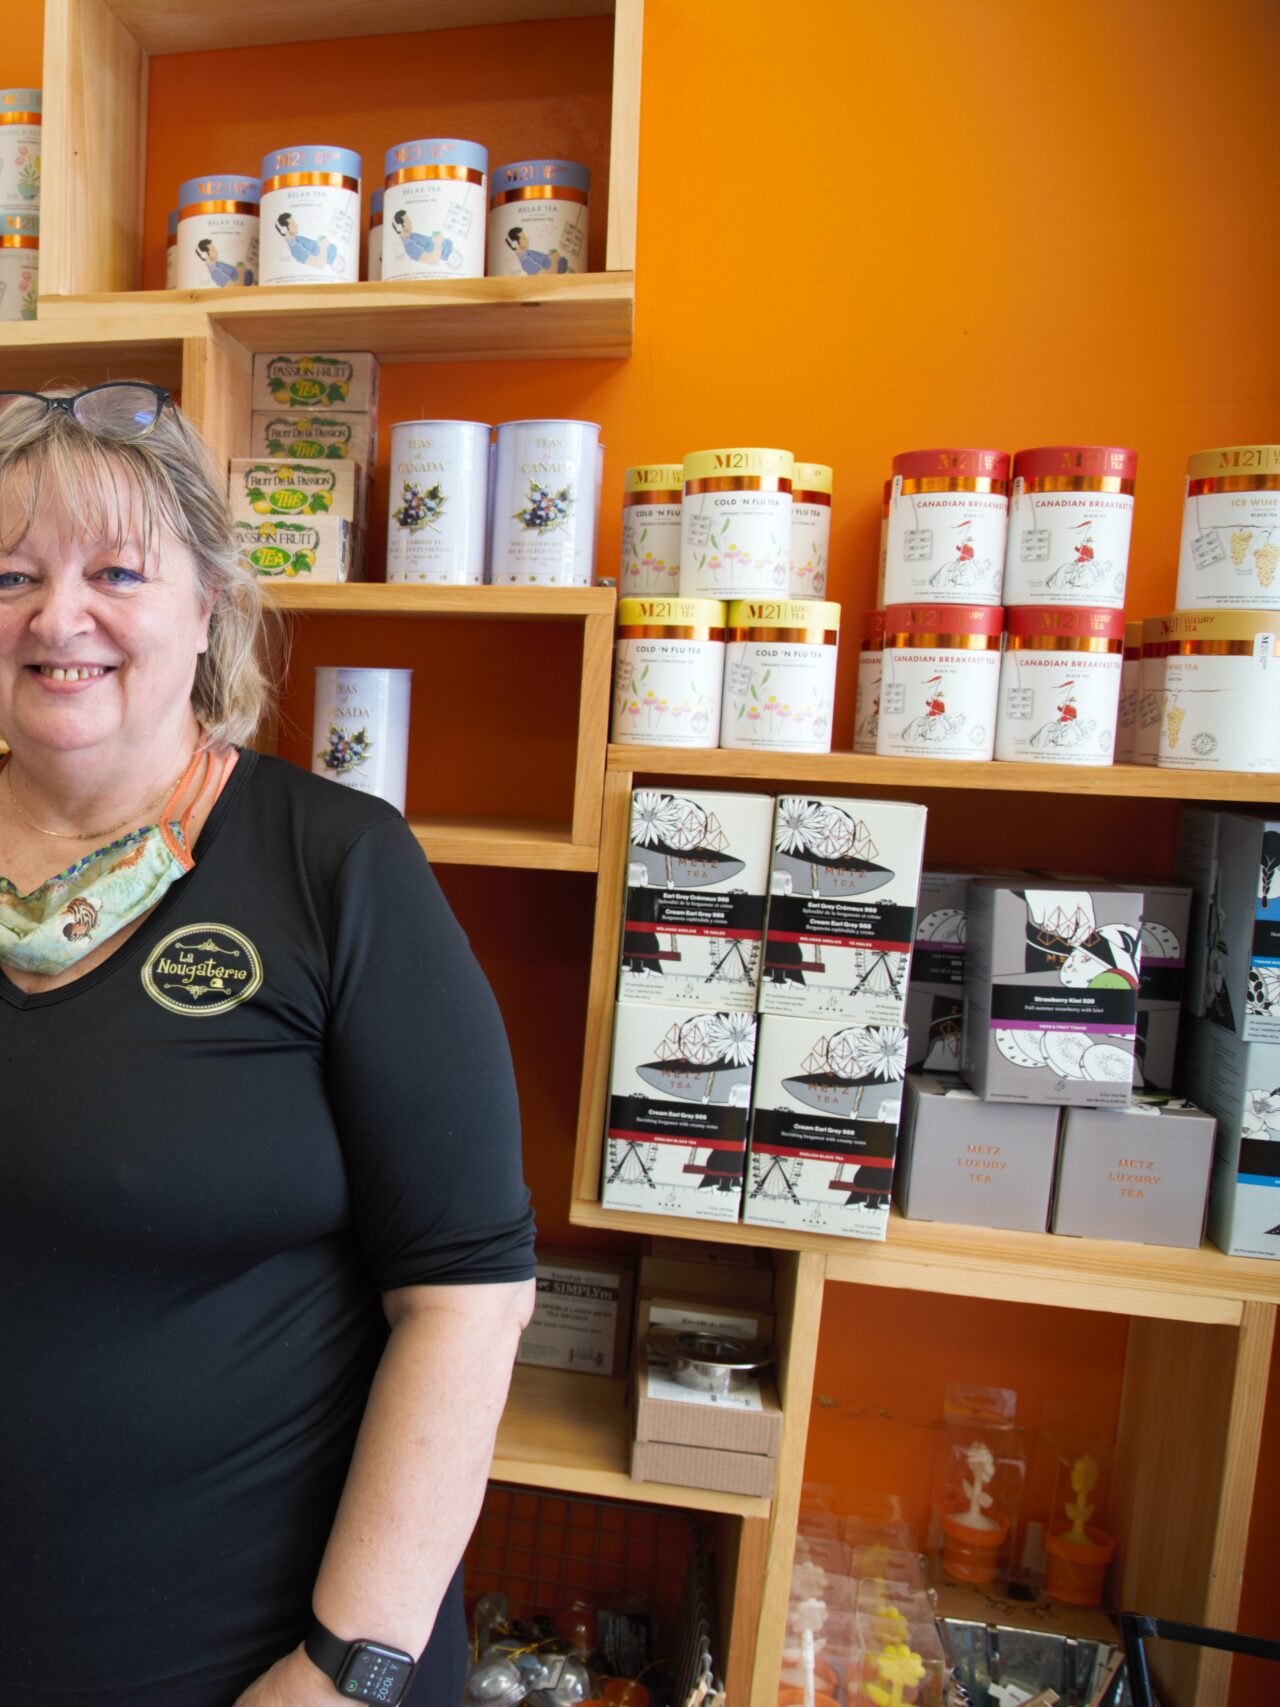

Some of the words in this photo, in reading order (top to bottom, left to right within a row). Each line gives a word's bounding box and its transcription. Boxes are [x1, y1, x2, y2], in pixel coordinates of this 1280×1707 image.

[504, 165, 535, 184] M21
[312, 191, 327, 199] TEA
[403, 187, 425, 196] RELAX
[426, 186, 442, 194] TEA
[208, 219, 231, 227] RELAX
[233, 219, 245, 227] TEA
[273, 366, 314, 377] PASSION
[315, 367, 346, 377] FRUIT
[296, 379, 321, 397] TEA
[408, 439, 433, 449] TEAS
[535, 438, 564, 449] TEAS
[714, 454, 749, 469] M21
[938, 453, 977, 470] M21
[1061, 452, 1101, 469] M21
[1218, 450, 1262, 468] M21
[397, 462, 446, 473] CANADA
[250, 475, 272, 486] FRUIT
[297, 476, 331, 486] PASSION
[635, 470, 664, 485] M21
[714, 499, 737, 507] COLD
[752, 498, 766, 506] FLU
[916, 500, 966, 509] CANADIAN
[968, 500, 1005, 510] BREAKFAST
[1035, 500, 1086, 509] CANADIAN
[1089, 500, 1127, 511] BREAKFAST
[1231, 499, 1246, 507] ICE
[1250, 499, 1278, 507] WINE
[635, 510, 654, 518] COLD
[666, 509, 681, 517] FLU
[795, 509, 809, 517] FLU
[809, 510, 822, 518] TEA
[236, 532, 277, 544] ASSION
[279, 533, 314, 545] FRUIT
[256, 547, 285, 566] TEA
[639, 602, 671, 618] M21
[747, 604, 781, 620] M21
[791, 612, 806, 620] TEA
[905, 610, 943, 627] M21
[1040, 612, 1081, 629] M21
[1184, 616, 1216, 625] LUXURY
[1090, 622, 1105, 631] TEA
[1184, 625, 1198, 633] TEA
[635, 646, 657, 654] COLD
[670, 646, 686, 654] FLU
[688, 647, 701, 655] TEA
[755, 649, 779, 658] COLD
[793, 650, 808, 658] FLU
[810, 651, 823, 659] TEA
[893, 655, 936, 664] CANADIAN
[938, 655, 985, 665] BREAKFAST
[1019, 658, 1068, 668] CANADIAN
[1070, 659, 1114, 669] BREAKFAST
[678, 858, 719, 869] METZ
[686, 870, 708, 878] TEA
[825, 866, 868, 878] METZ
[833, 879, 856, 888] TEA
[675, 893, 689, 901] Grey
[689, 894, 717, 902] Crémeux
[807, 901, 820, 909] Earl
[820, 902, 835, 911] Grey
[835, 903, 864, 913] Crémeux
[665, 908, 685, 916] Cream
[685, 909, 698, 917] Earl
[698, 911, 712, 919] Grey
[809, 918, 831, 926] Cream
[843, 921, 859, 930] Grey
[179, 951, 194, 963] La
[1046, 953, 1090, 964] METZ
[156, 957, 247, 984] Nougaterie
[1034, 996, 1068, 1004] Strawberry
[660, 1069, 703, 1081] METZ
[670, 1081, 692, 1089] TEA
[807, 1082, 850, 1095] METZ
[817, 1095, 839, 1103] TEA
[648, 1108, 668, 1116] Cream
[668, 1110, 680, 1118] Earl
[680, 1112, 695, 1120] Grey
[793, 1123, 815, 1131] Cream
[814, 1125, 827, 1133] Earl
[827, 1127, 842, 1135] Grey
[967, 1144, 1002, 1156] METZ
[957, 1158, 1008, 1170] LUXURY
[1118, 1158, 1155, 1171] METZ
[969, 1173, 993, 1184] TEA
[1108, 1171, 1162, 1186] LUXURY
[1120, 1187, 1145, 1198] TEA
[376, 1676, 395, 1701] 10:02
